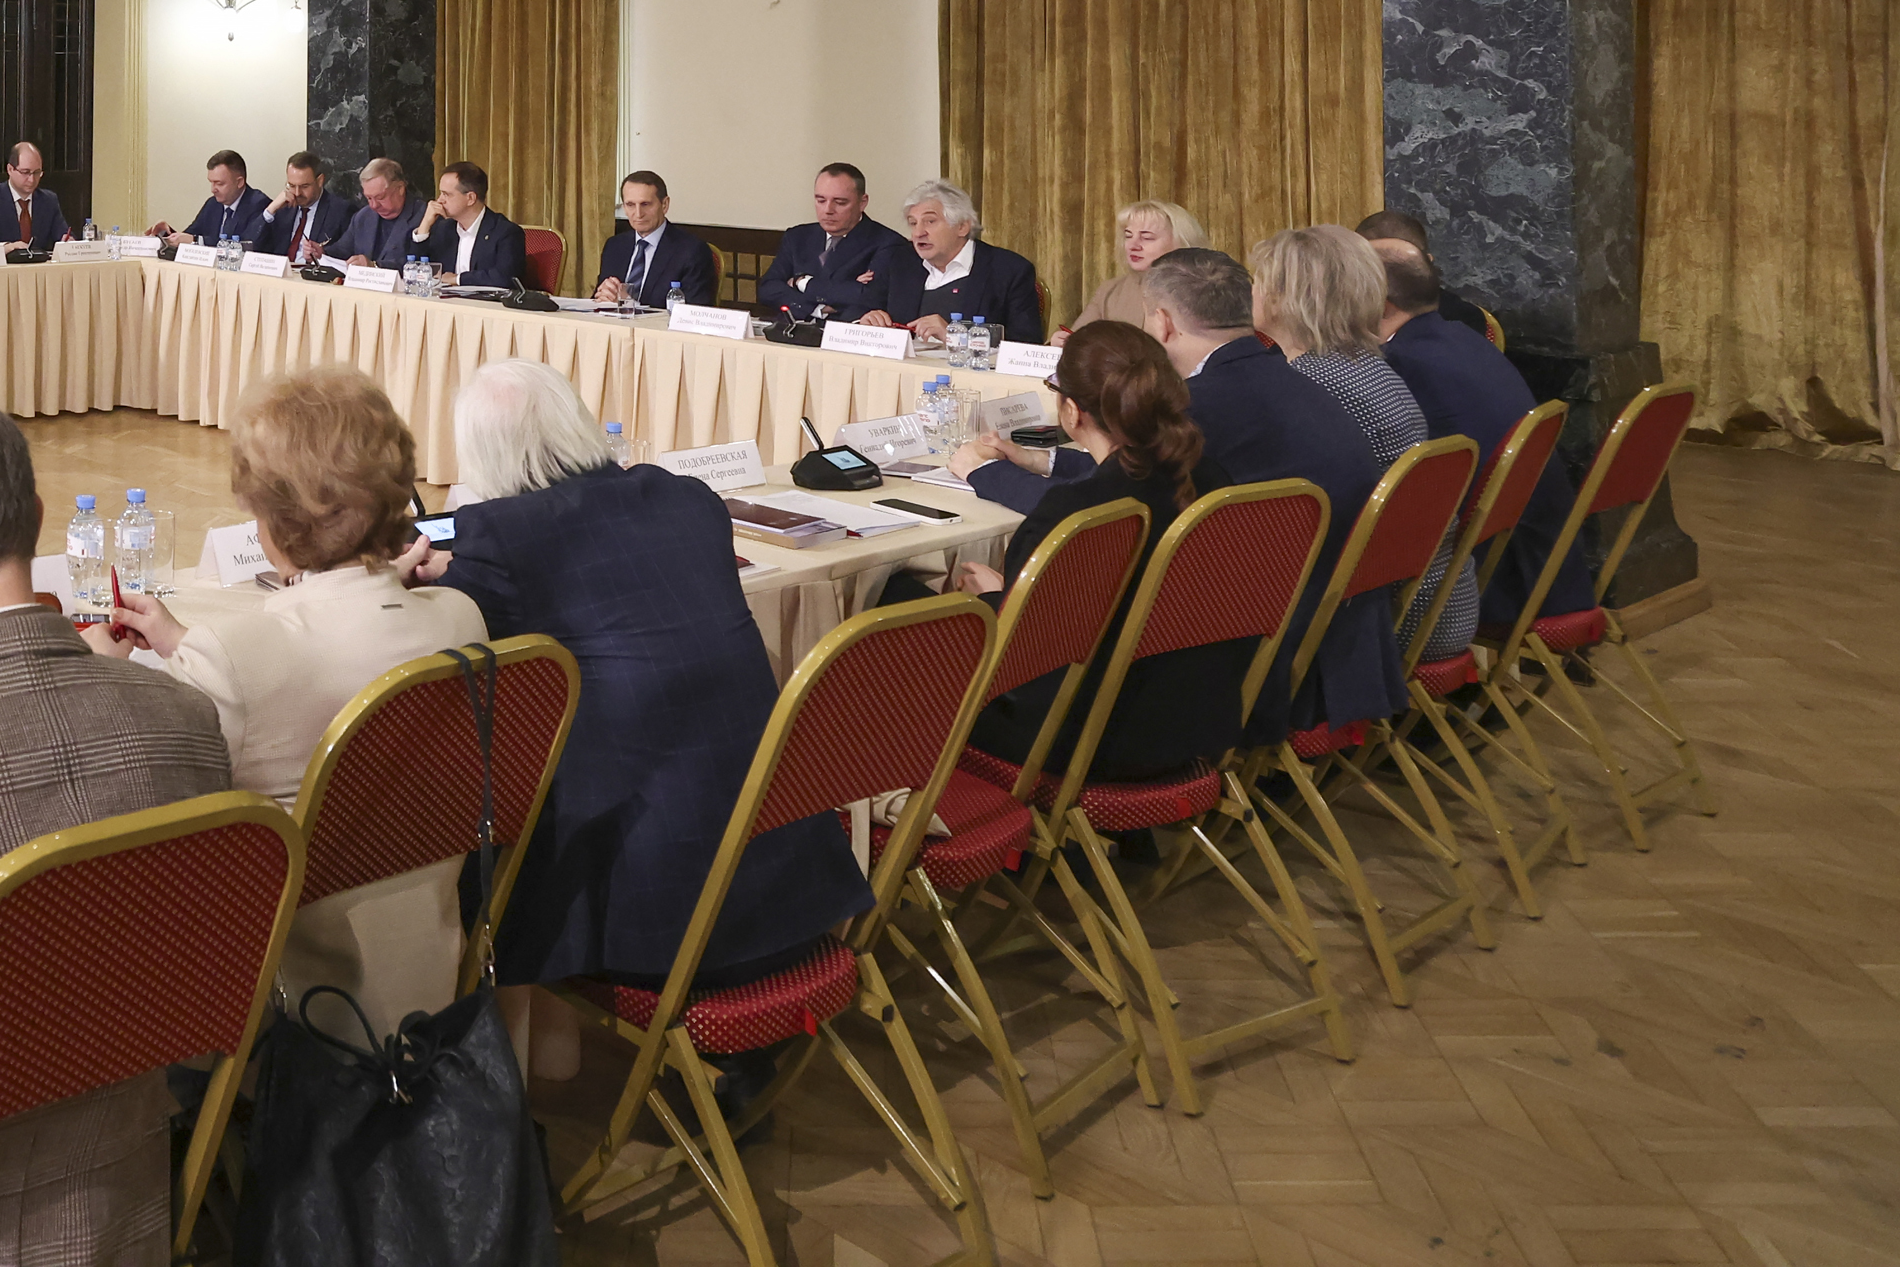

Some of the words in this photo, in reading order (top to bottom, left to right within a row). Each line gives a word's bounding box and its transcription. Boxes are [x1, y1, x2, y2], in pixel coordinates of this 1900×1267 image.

[690, 310, 727, 321] МОЛЧАНОВ
[844, 328, 886, 340] ГРИГОРЬЕВ
[828, 335, 860, 346] Владимир
[1007, 358, 1032, 368] Жанна
[677, 449, 748, 470] ПОДОБРЕЕВСКАЯ
[710, 466, 747, 480] Сергеевна
